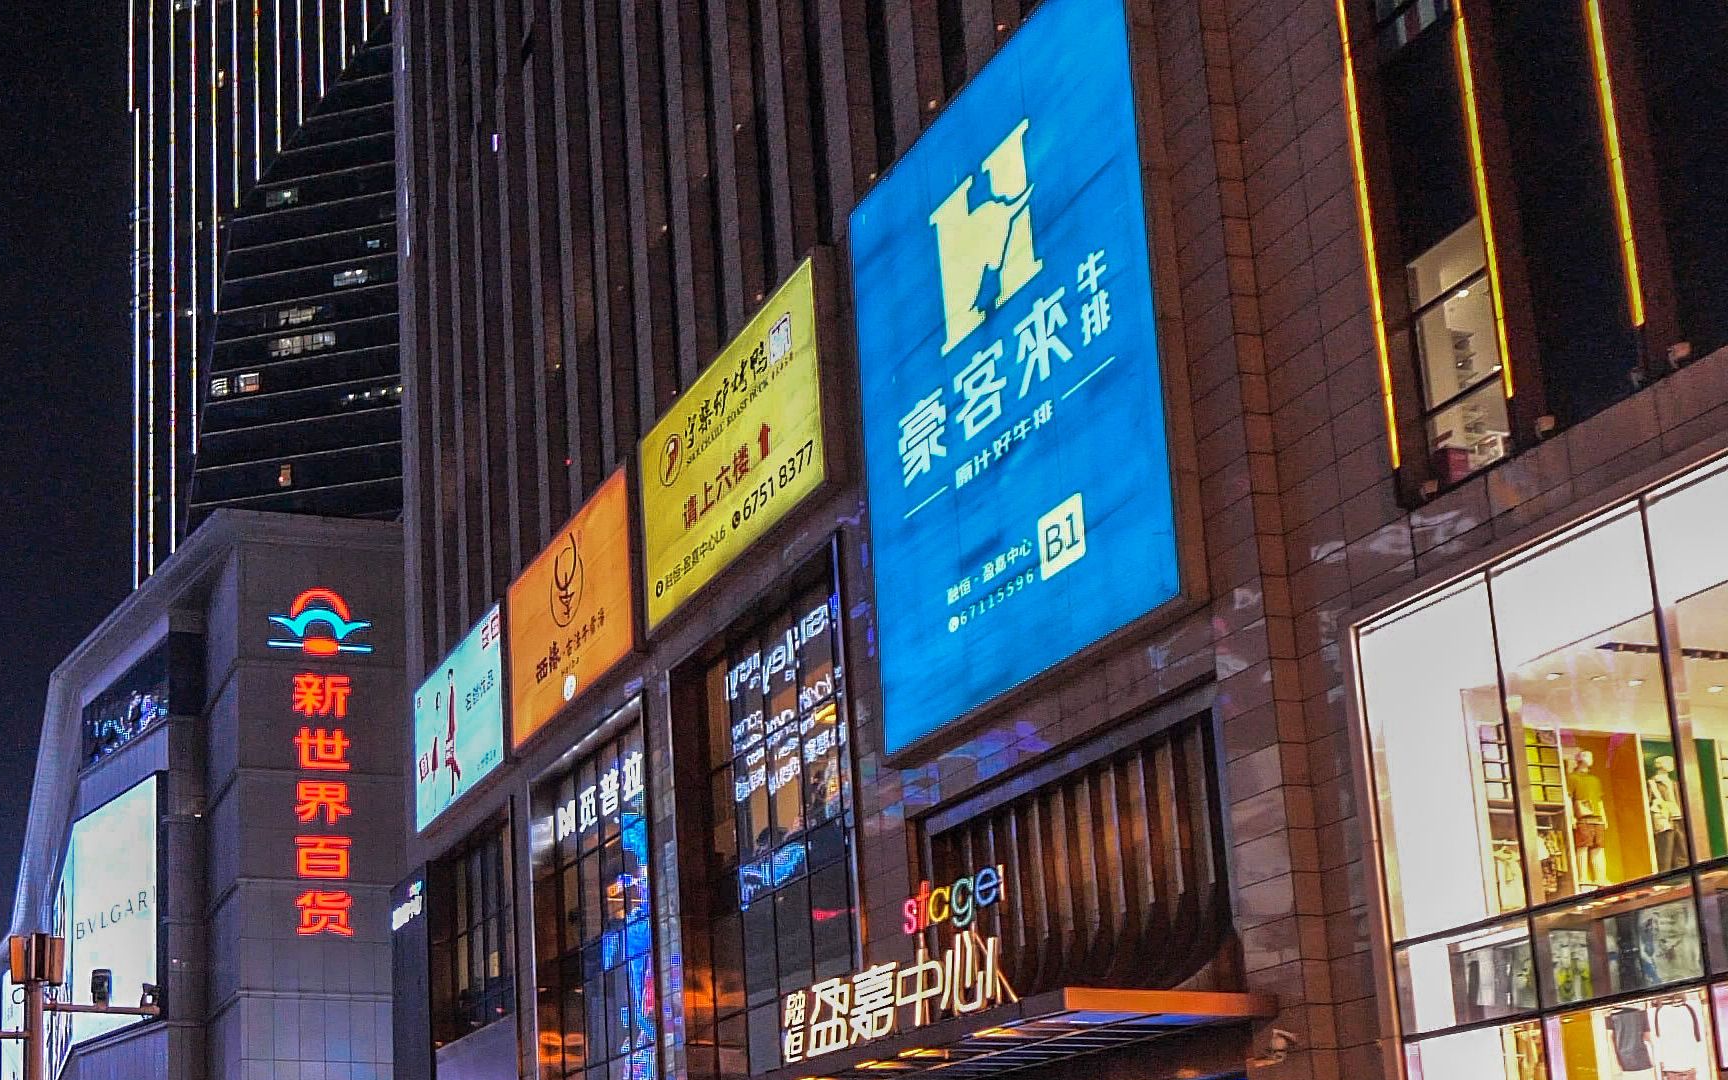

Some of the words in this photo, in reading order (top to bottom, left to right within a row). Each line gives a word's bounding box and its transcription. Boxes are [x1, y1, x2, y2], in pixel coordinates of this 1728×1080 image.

[1077, 249, 1110, 346] 牛排
[898, 286, 1073, 488] 豪客來
[683, 444, 750, 529] 请上六楼
[743, 477, 774, 521] 6751
[778, 440, 813, 489] 8377
[955, 400, 1053, 489] 原汁好牛排
[1045, 511, 1081, 563] B1
[960, 568, 1034, 625] 67115596
[293, 673, 354, 937] 新世界百货
[806, 931, 998, 1057] 盈嘉中心
